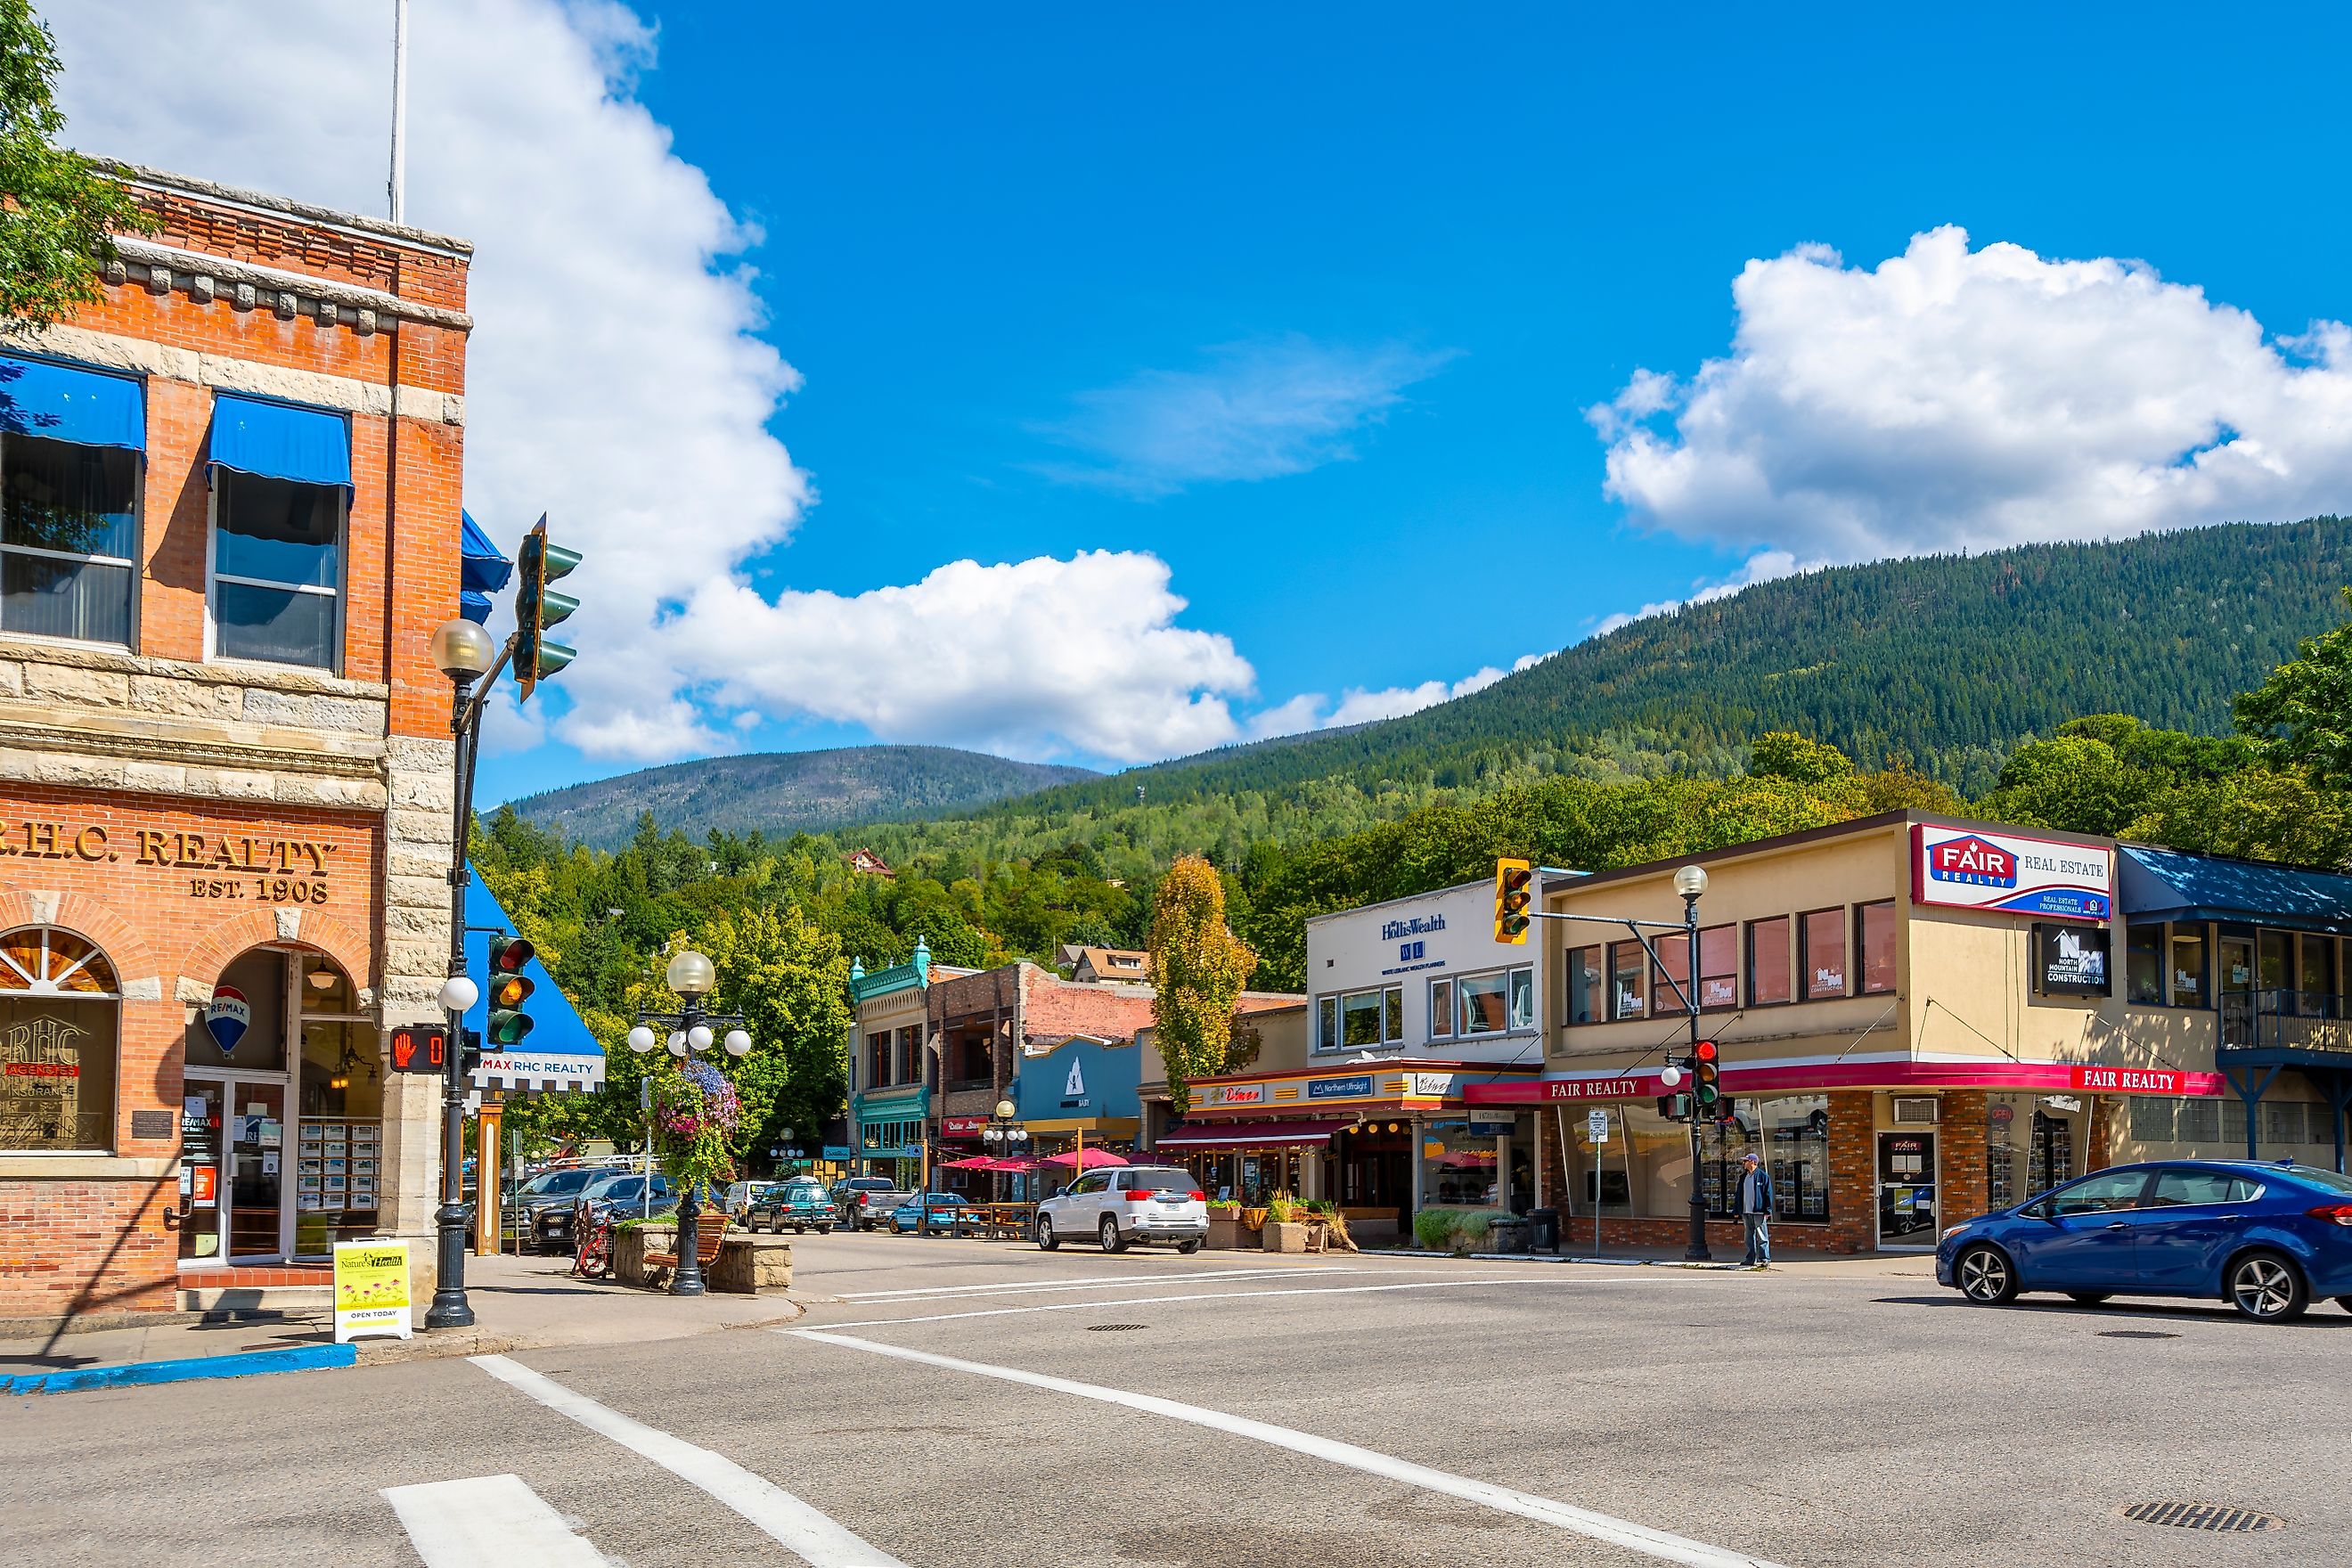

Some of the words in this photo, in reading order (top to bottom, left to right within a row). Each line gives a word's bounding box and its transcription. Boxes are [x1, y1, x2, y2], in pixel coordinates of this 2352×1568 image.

[0, 821, 119, 862] .H.C.
[136, 831, 338, 877] REALTY
[1942, 847, 2005, 873] FAIR
[2025, 855, 2056, 872] REAL
[2060, 860, 2103, 878] ESTATE
[1942, 871, 2006, 886] REALTY
[190, 878, 245, 899] EST.
[256, 878, 330, 904] 1908
[2039, 902, 2081, 913] PROFESSIONALS
[2058, 897, 2078, 905] ESTATE
[1382, 913, 1446, 941] HollisWealth
[2049, 963, 2078, 972] MOUNTAIN
[2058, 958, 2078, 966] NORTH
[2047, 973, 2104, 984] CONSTRUCTION
[211, 1002, 245, 1017] RE/MAX
[7, 1019, 79, 1065] RHC
[429, 1036, 443, 1064] 0
[10, 1066, 75, 1075] AGENCIES
[514, 1061, 540, 1072] RHC
[544, 1063, 593, 1074] REALTY
[1324, 1083, 1346, 1092] Northern
[1346, 1081, 1368, 1092] Ultralight
[2084, 1070, 2117, 1087] FAIR
[2122, 1072, 2175, 1090] REALTY
[8, 1087, 75, 1097] INSURANCE
[1551, 1083, 1581, 1098] FAIR
[1586, 1080, 1637, 1096] REALTY
[1992, 1109, 2011, 1120] OPEN
[341, 1260, 372, 1269] Nature's
[373, 1256, 402, 1267] Health
